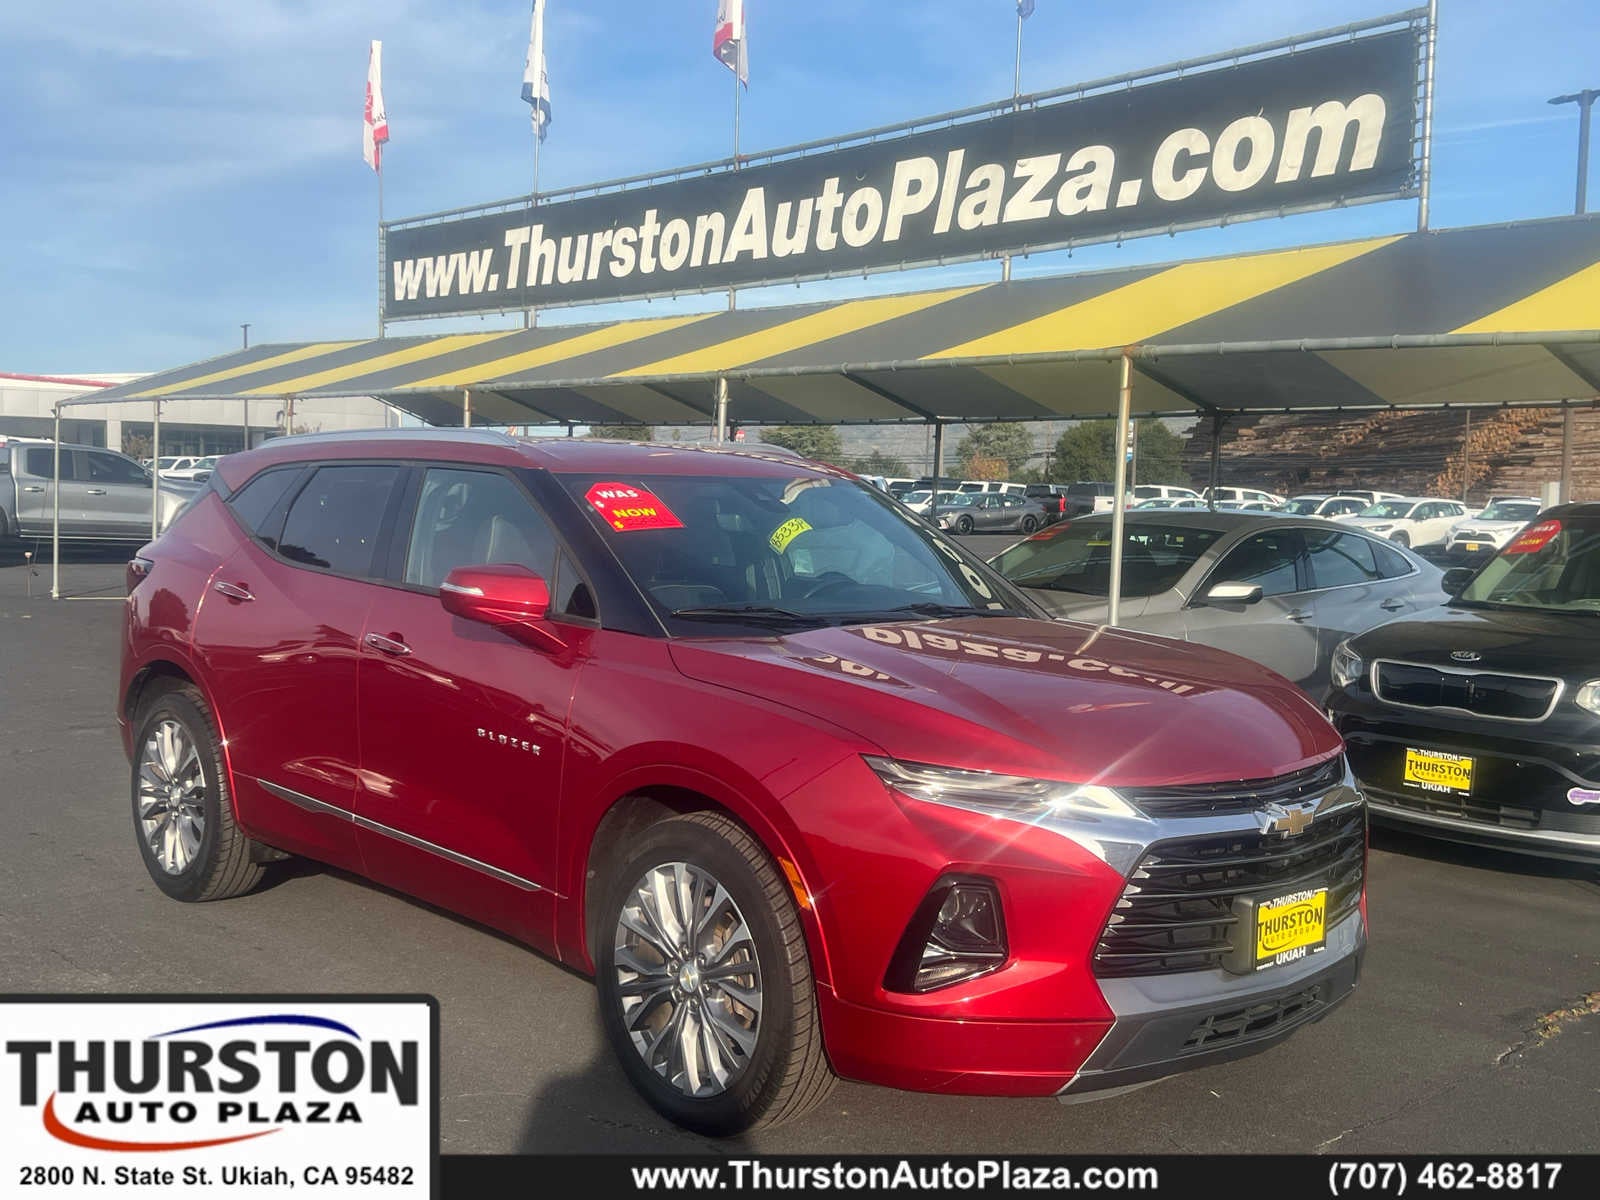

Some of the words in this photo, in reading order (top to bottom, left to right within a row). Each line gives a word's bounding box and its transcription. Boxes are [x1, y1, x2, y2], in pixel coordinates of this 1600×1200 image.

[393, 94, 1386, 301] www.ThurstonAutoPlaza.com
[596, 489, 638, 498] WAS
[612, 507, 657, 518] NOW
[477, 728, 541, 756] BLAZER
[1419, 749, 1459, 761] THURSTON
[1407, 759, 1471, 780] THURSTON
[1421, 781, 1451, 794] UKIAH
[1272, 889, 1313, 908] THURSTON
[1257, 906, 1323, 942] THURSTON
[1275, 945, 1306, 965] UKIAH
